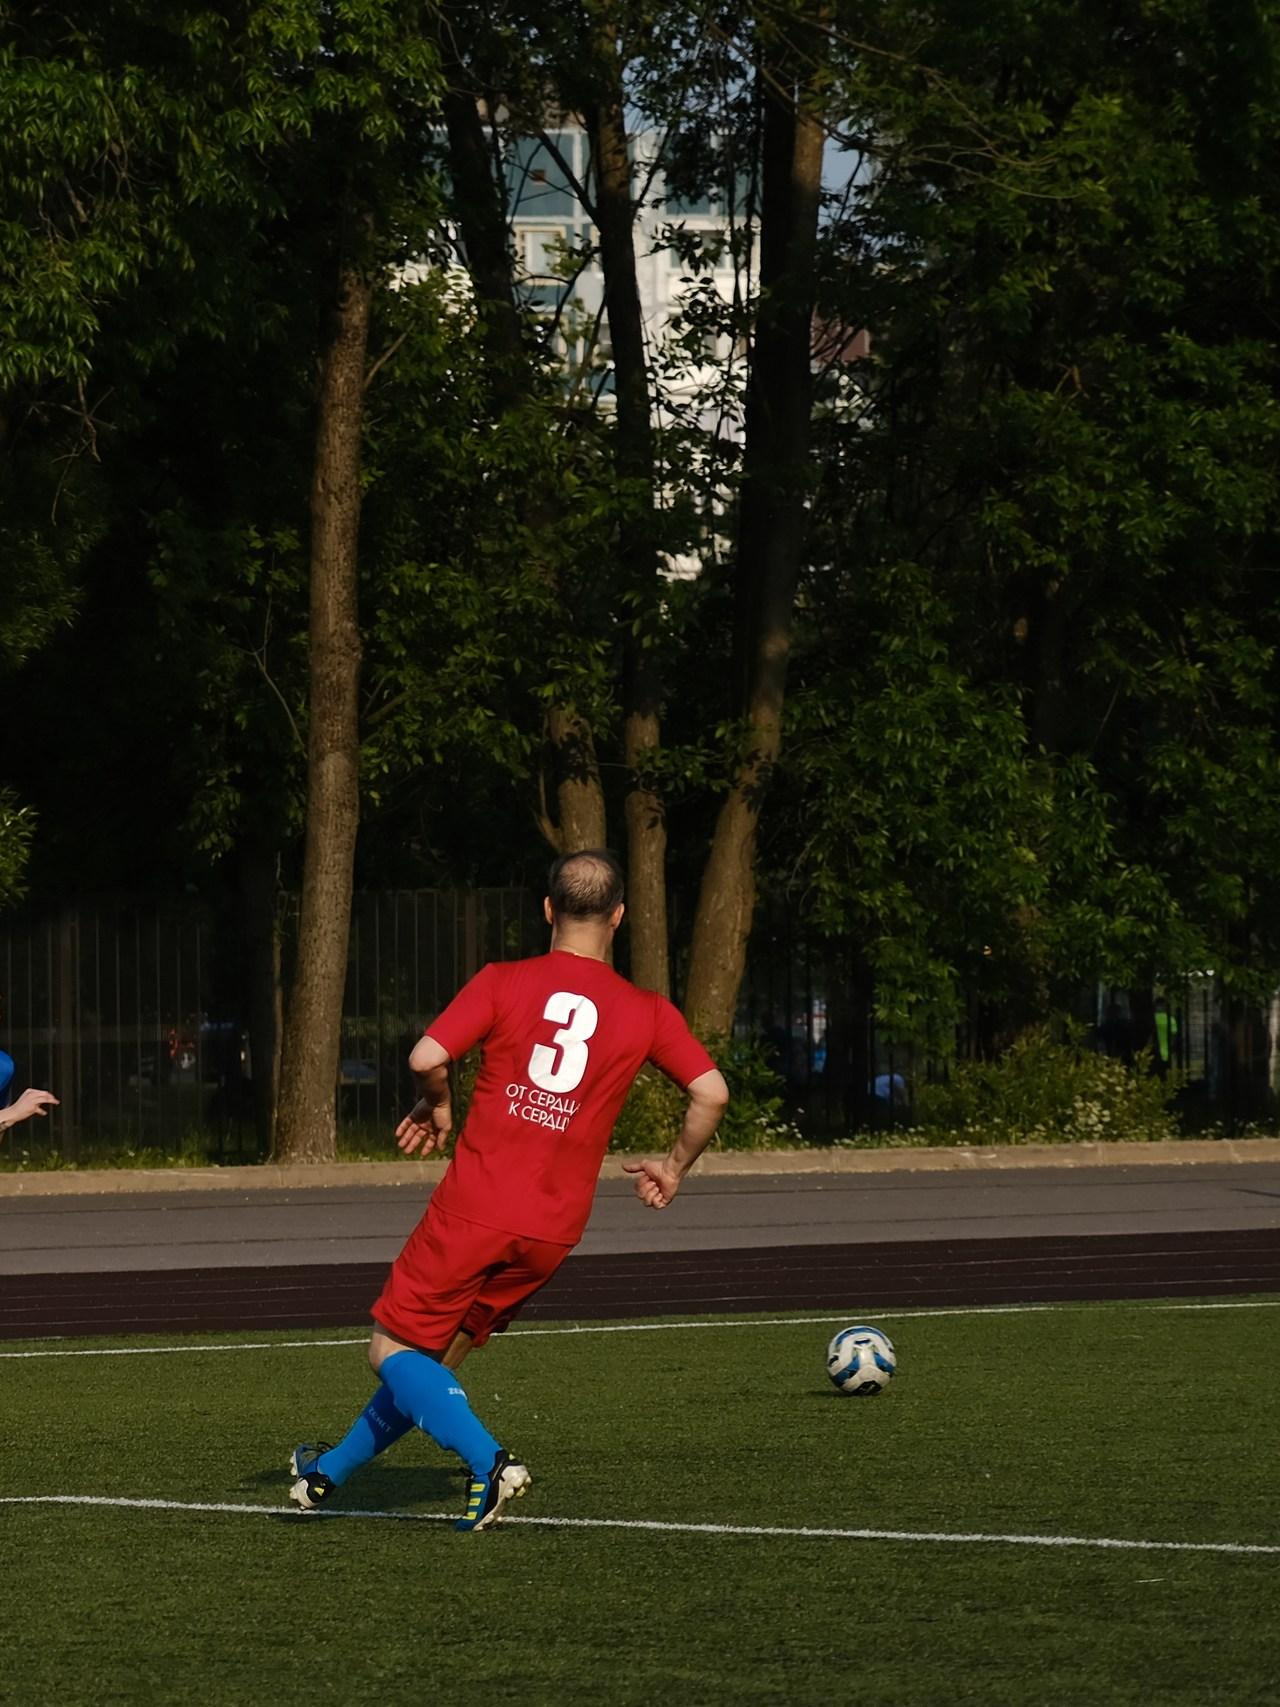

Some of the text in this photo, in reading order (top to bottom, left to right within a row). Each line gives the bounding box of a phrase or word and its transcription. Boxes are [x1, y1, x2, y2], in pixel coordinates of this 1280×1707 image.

[528, 991, 599, 1094] 3
[506, 1083, 528, 1100] ОТ
[508, 1101, 521, 1117] К
